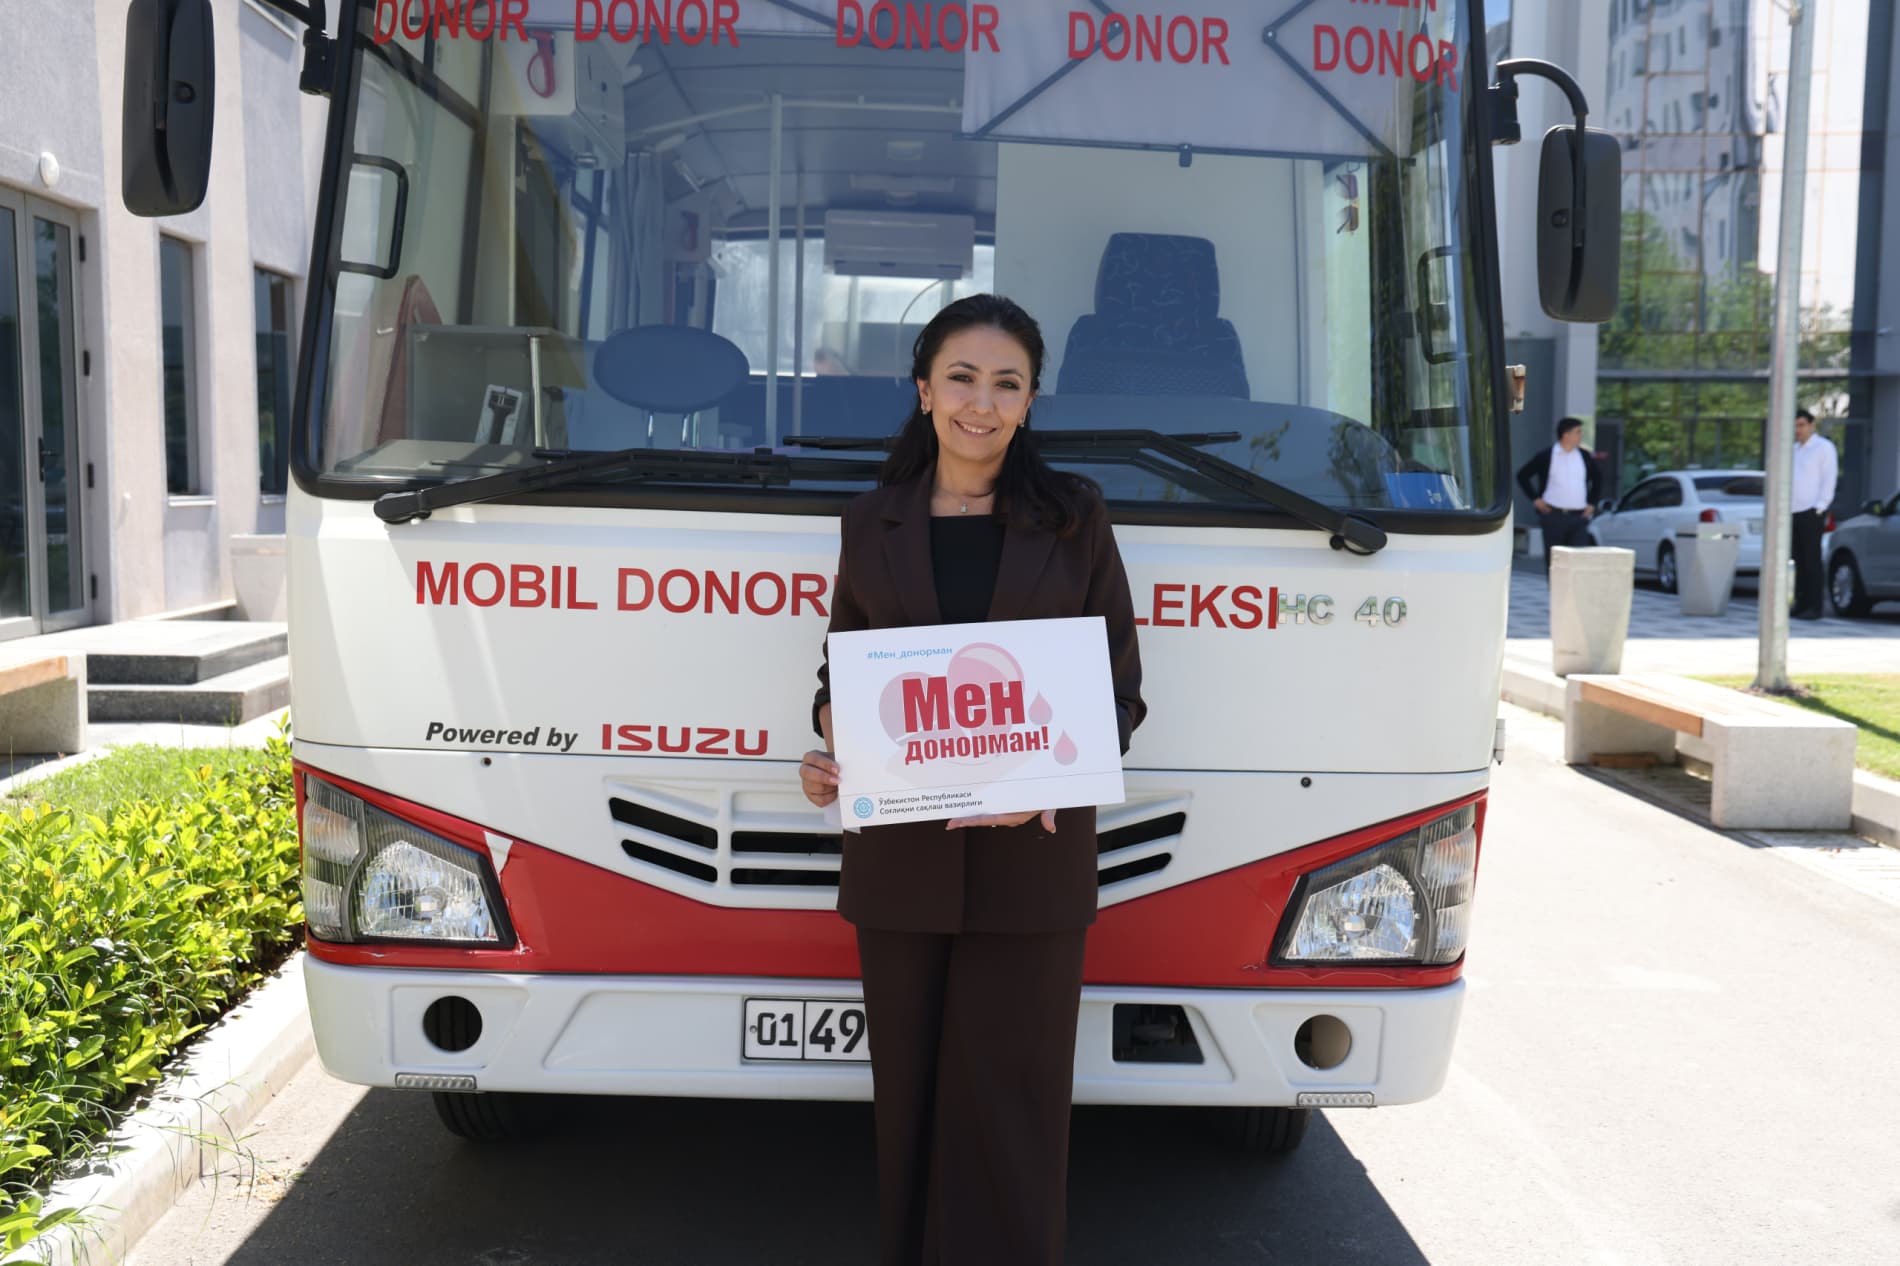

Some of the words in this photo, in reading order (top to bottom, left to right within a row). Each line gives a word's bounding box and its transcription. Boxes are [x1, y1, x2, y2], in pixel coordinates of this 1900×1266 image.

[374, 0, 529, 45] DONOR
[575, 0, 740, 47] DONOR
[836, 0, 1000, 53] DONOR
[1068, 12, 1230, 65] DONOR
[1313, 24, 1458, 92] DONOR
[416, 561, 598, 610] MOBIL
[617, 567, 838, 617] DONOR
[1135, 583, 1279, 629] EKSI
[1277, 593, 1335, 626] HC
[1354, 595, 1408, 628] 40
[867, 647, 953, 660] #Мен_донорман
[902, 676, 1026, 733] Мен
[426, 722, 539, 746] Powered
[546, 727, 578, 752] by
[602, 723, 769, 756] ISUZU
[905, 726, 1050, 765] донорман!
[921, 791, 972, 803] Республикаси
[944, 800, 983, 809] вазирлиги
[757, 1013, 798, 1046] 01
[809, 1009, 866, 1053] 49
